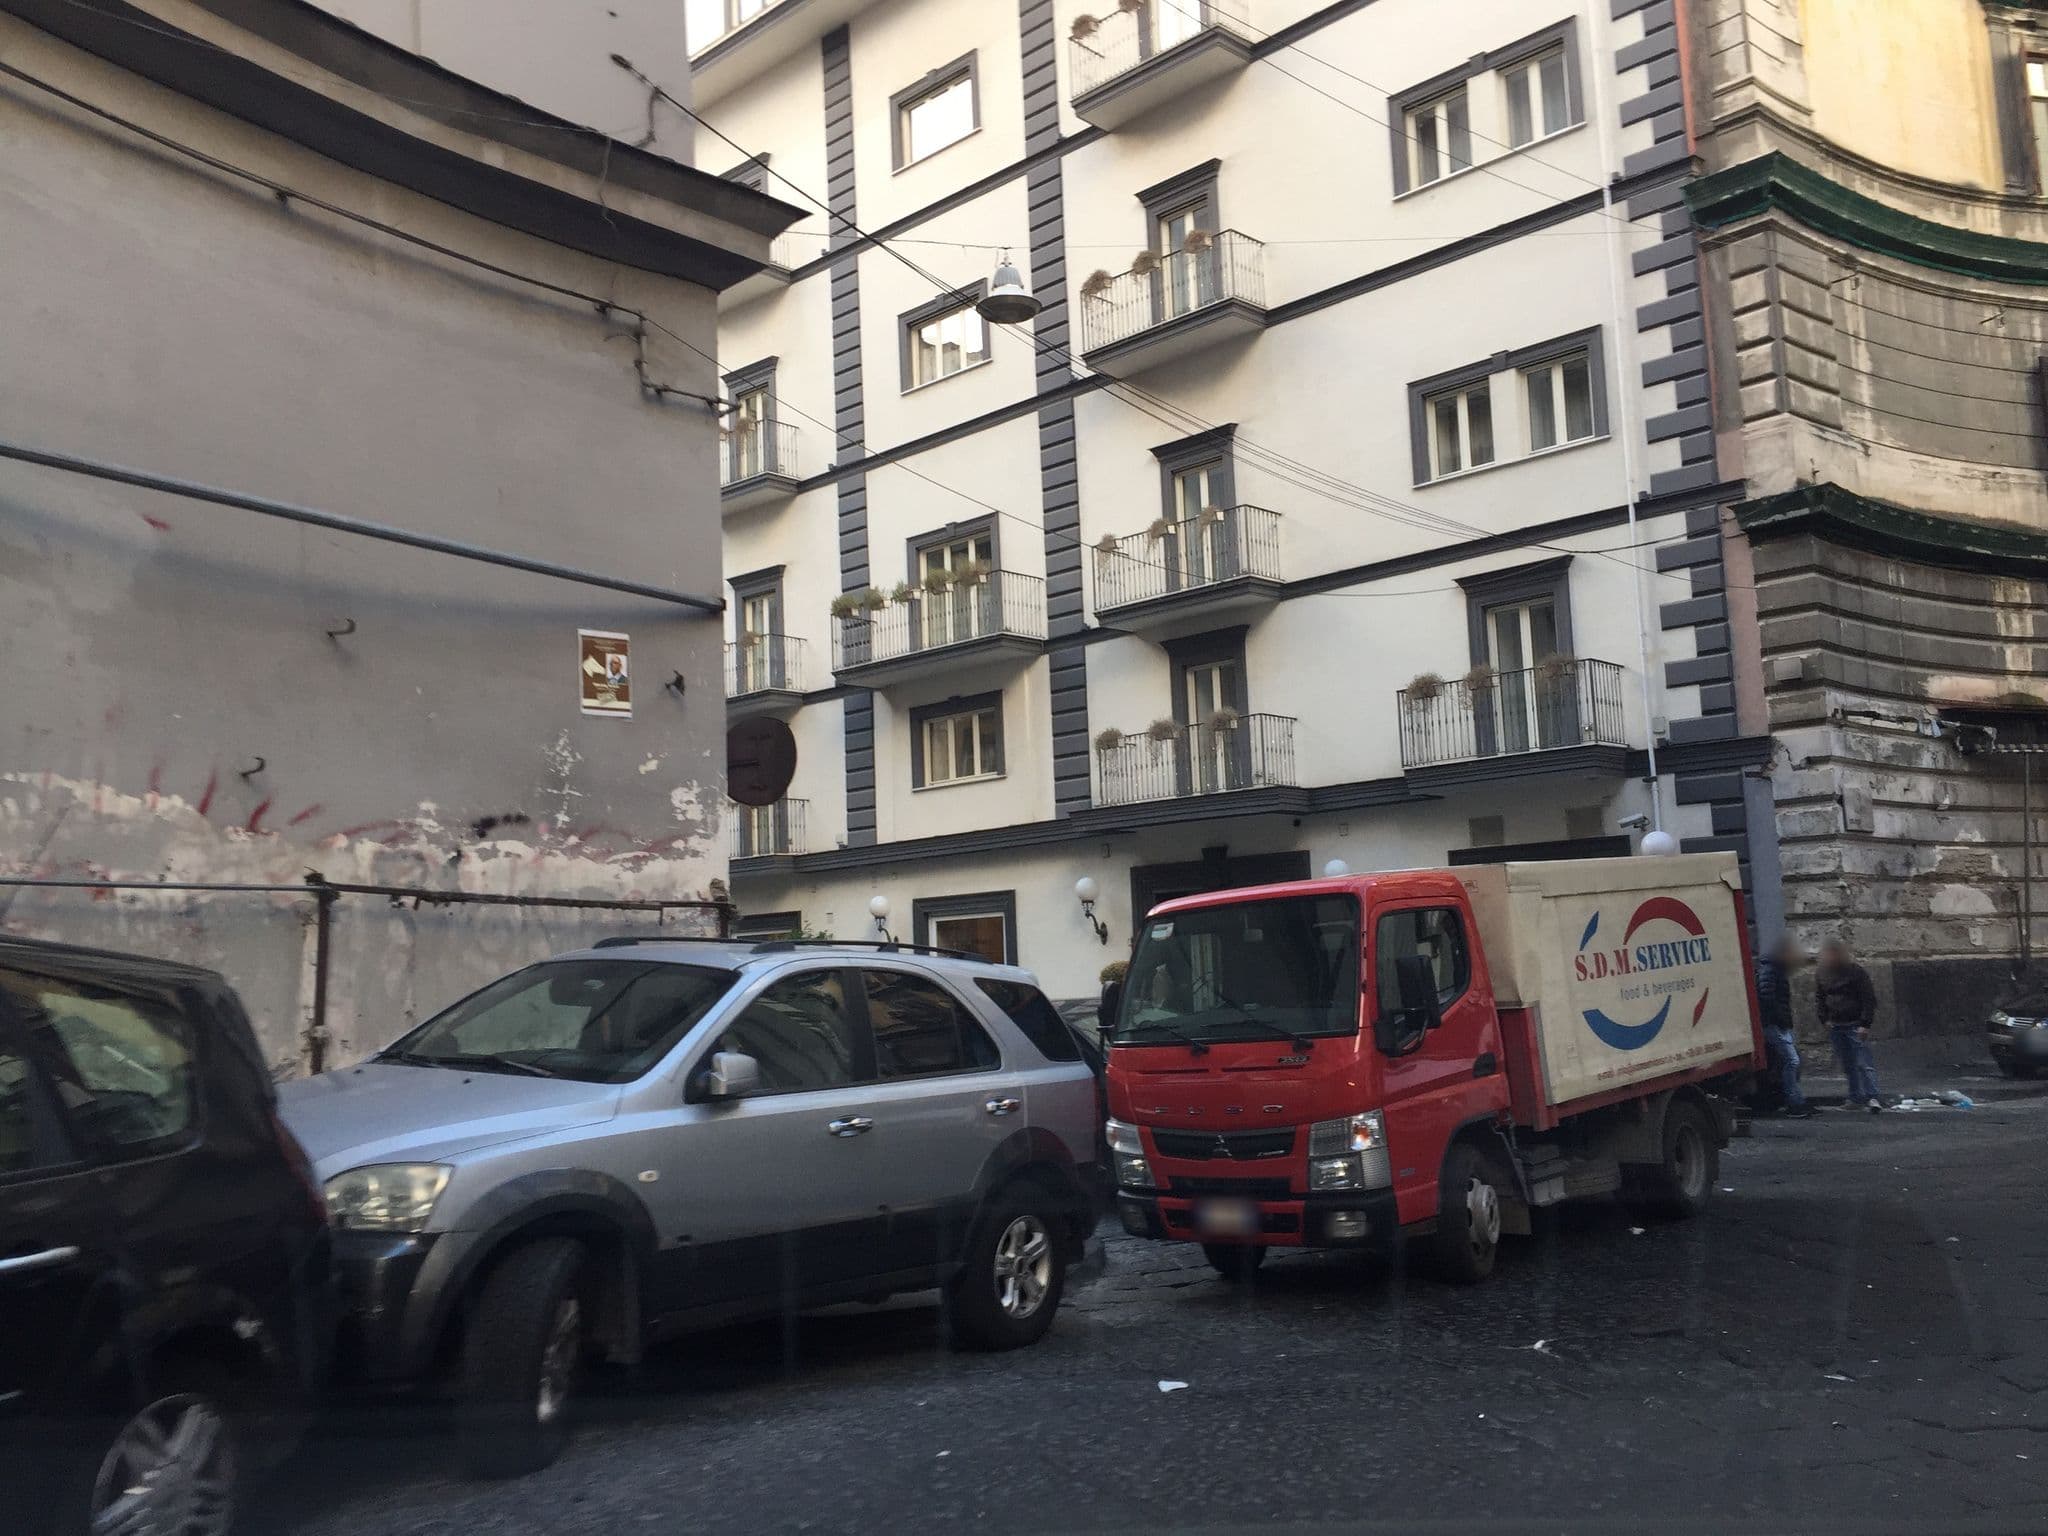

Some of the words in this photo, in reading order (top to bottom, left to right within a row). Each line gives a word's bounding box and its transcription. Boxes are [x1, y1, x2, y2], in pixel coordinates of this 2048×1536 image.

[1575, 937, 1711, 981] S.D.M.SERVICE
[1620, 984, 1640, 1000] food
[1643, 983, 1650, 997] &
[1652, 977, 1695, 995] beverages
